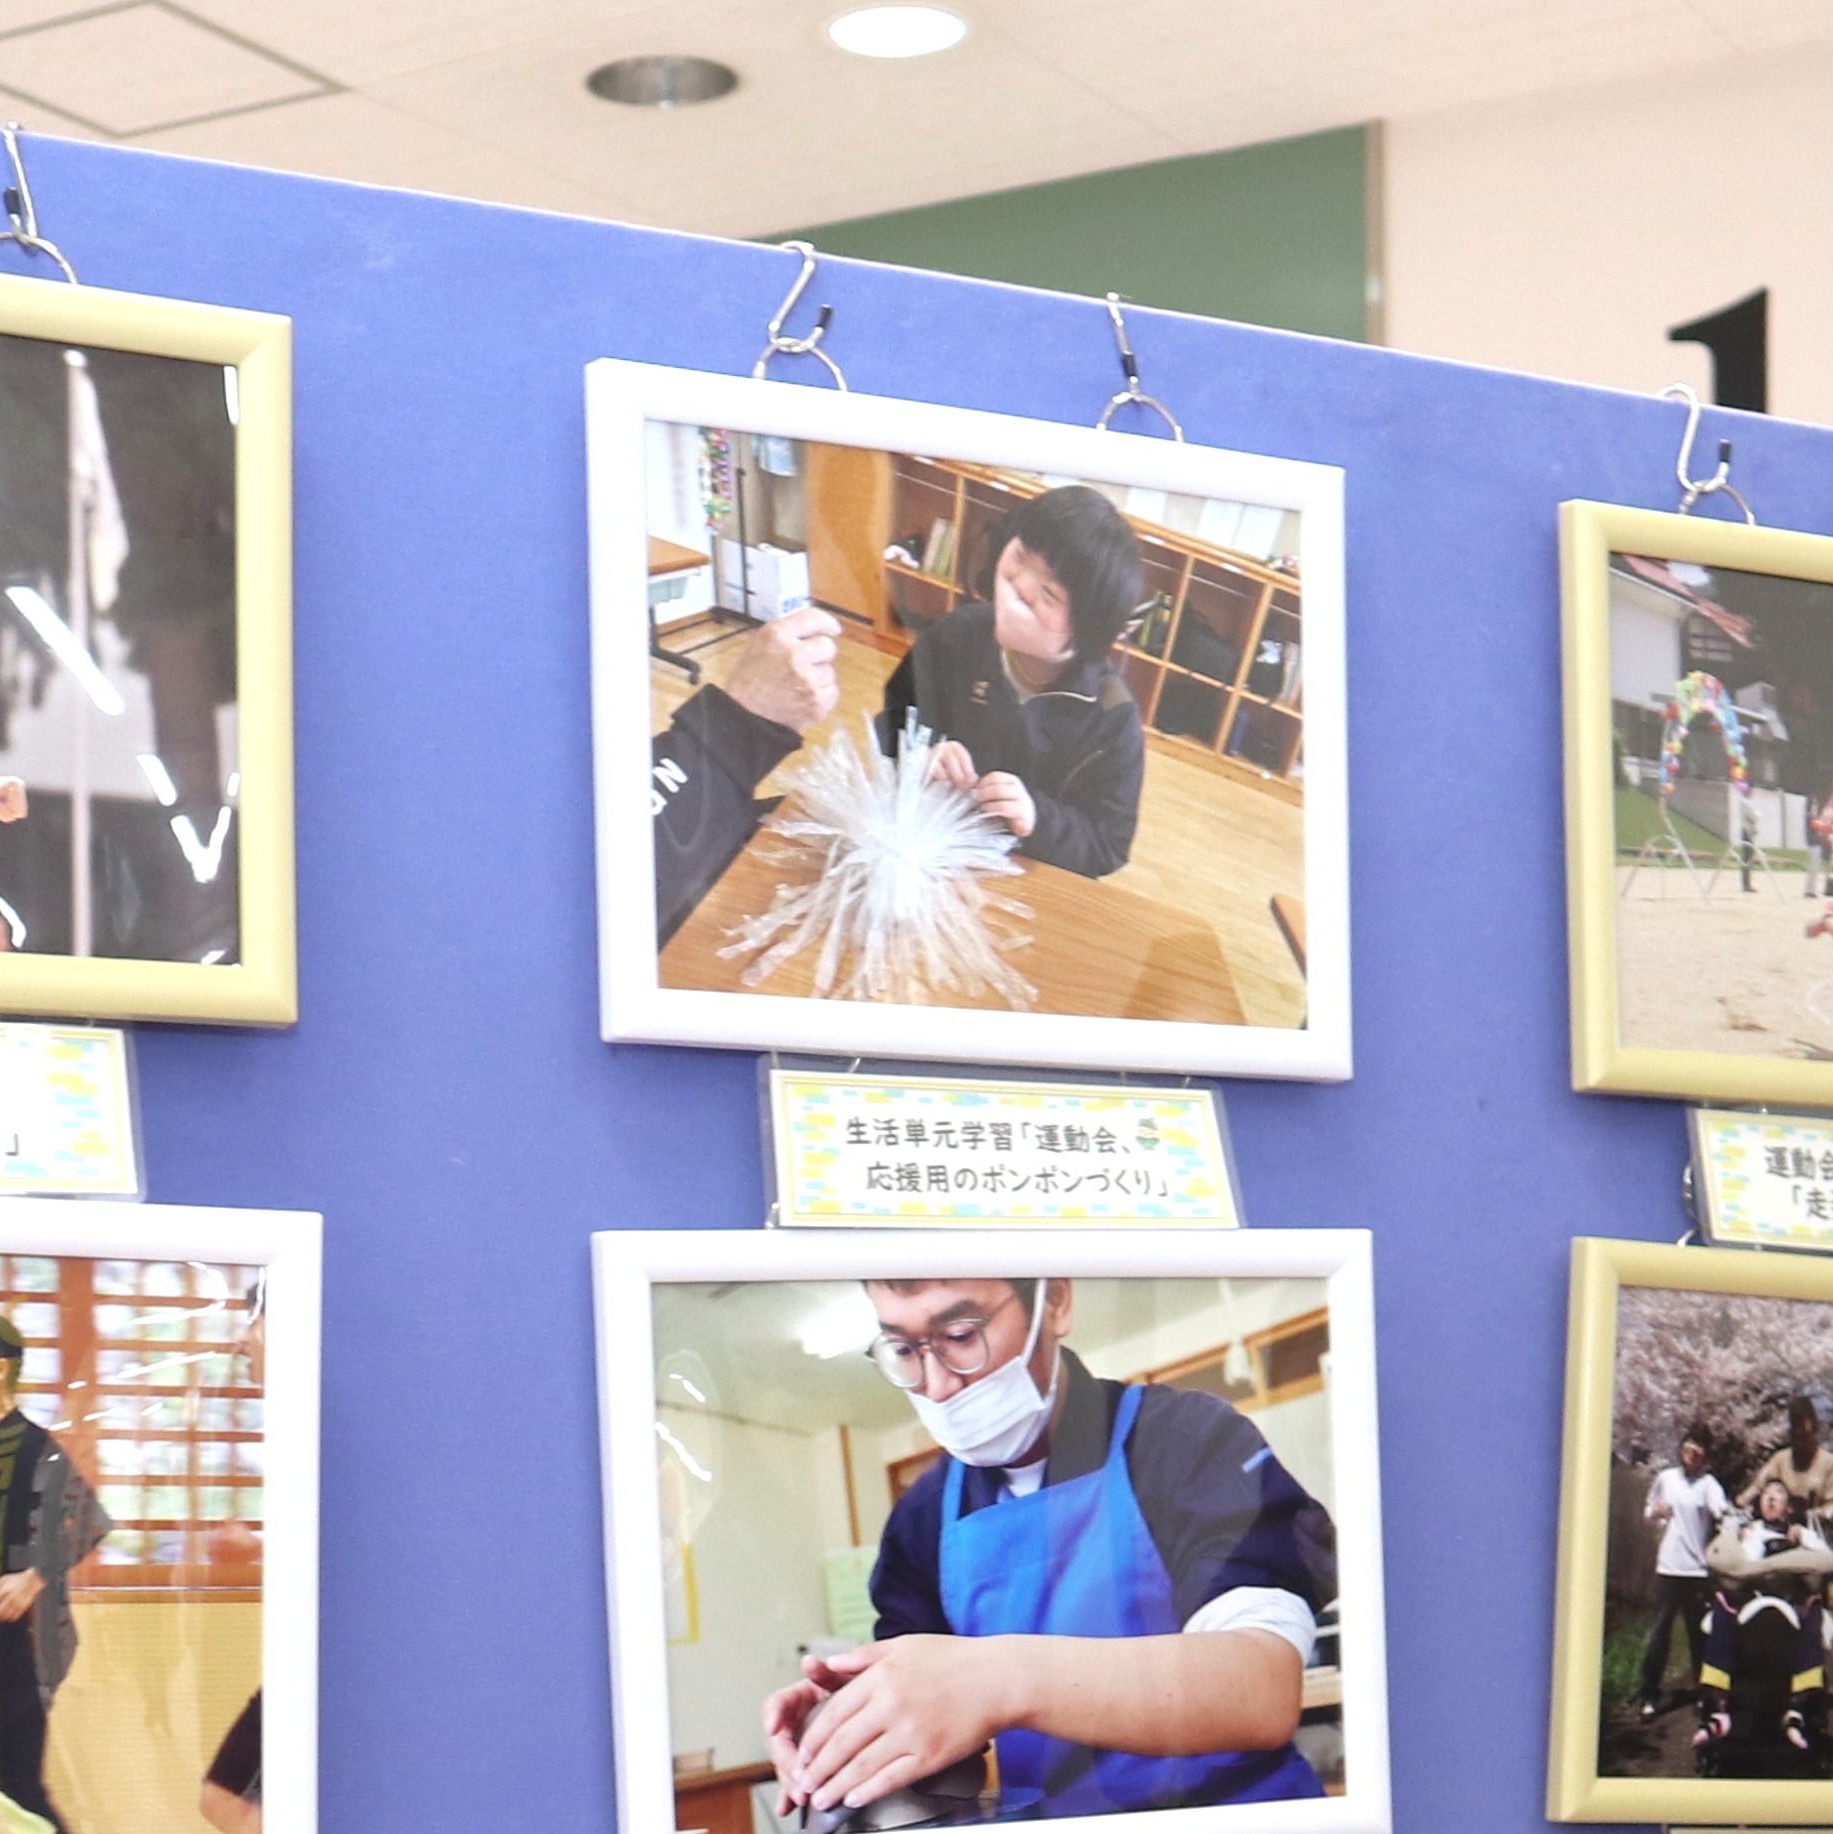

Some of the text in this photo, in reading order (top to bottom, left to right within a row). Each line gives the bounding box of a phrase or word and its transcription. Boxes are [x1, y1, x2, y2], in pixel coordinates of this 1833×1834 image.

[846, 1116, 1130, 1155] 生活単元学習「運動会、
[866, 1163, 1169, 1197] 応援用のポンポンづくり」
